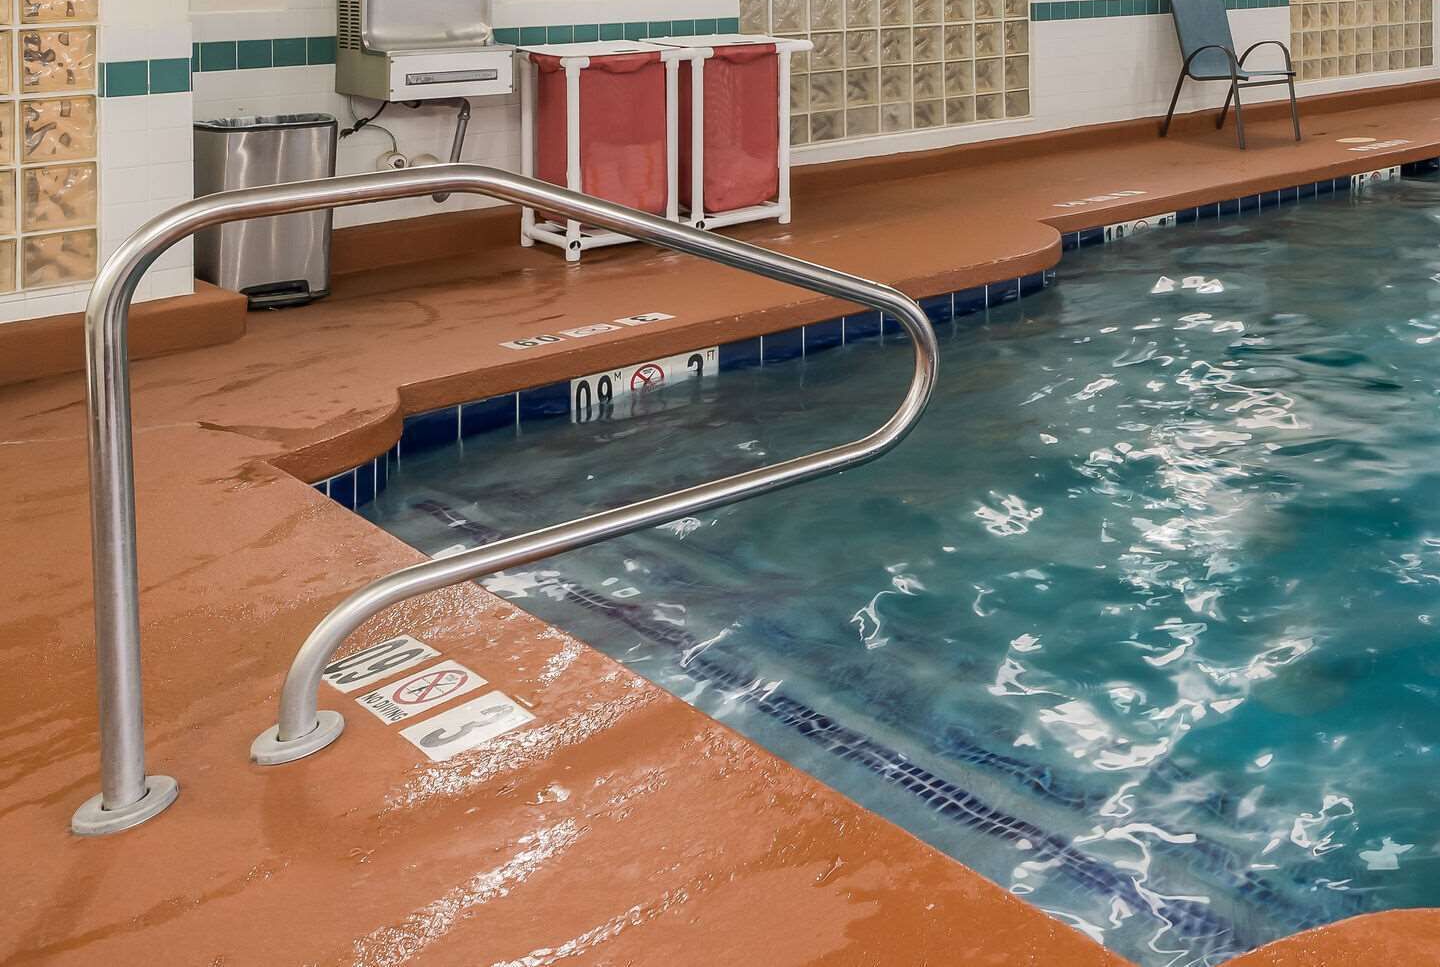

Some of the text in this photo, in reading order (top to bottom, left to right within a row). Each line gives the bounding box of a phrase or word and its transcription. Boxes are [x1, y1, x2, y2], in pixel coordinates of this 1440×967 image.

[614, 371, 622, 381] M
[706, 348, 716, 361] FT
[361, 692, 408, 722] NO DIVING
[419, 704, 515, 748] 3
